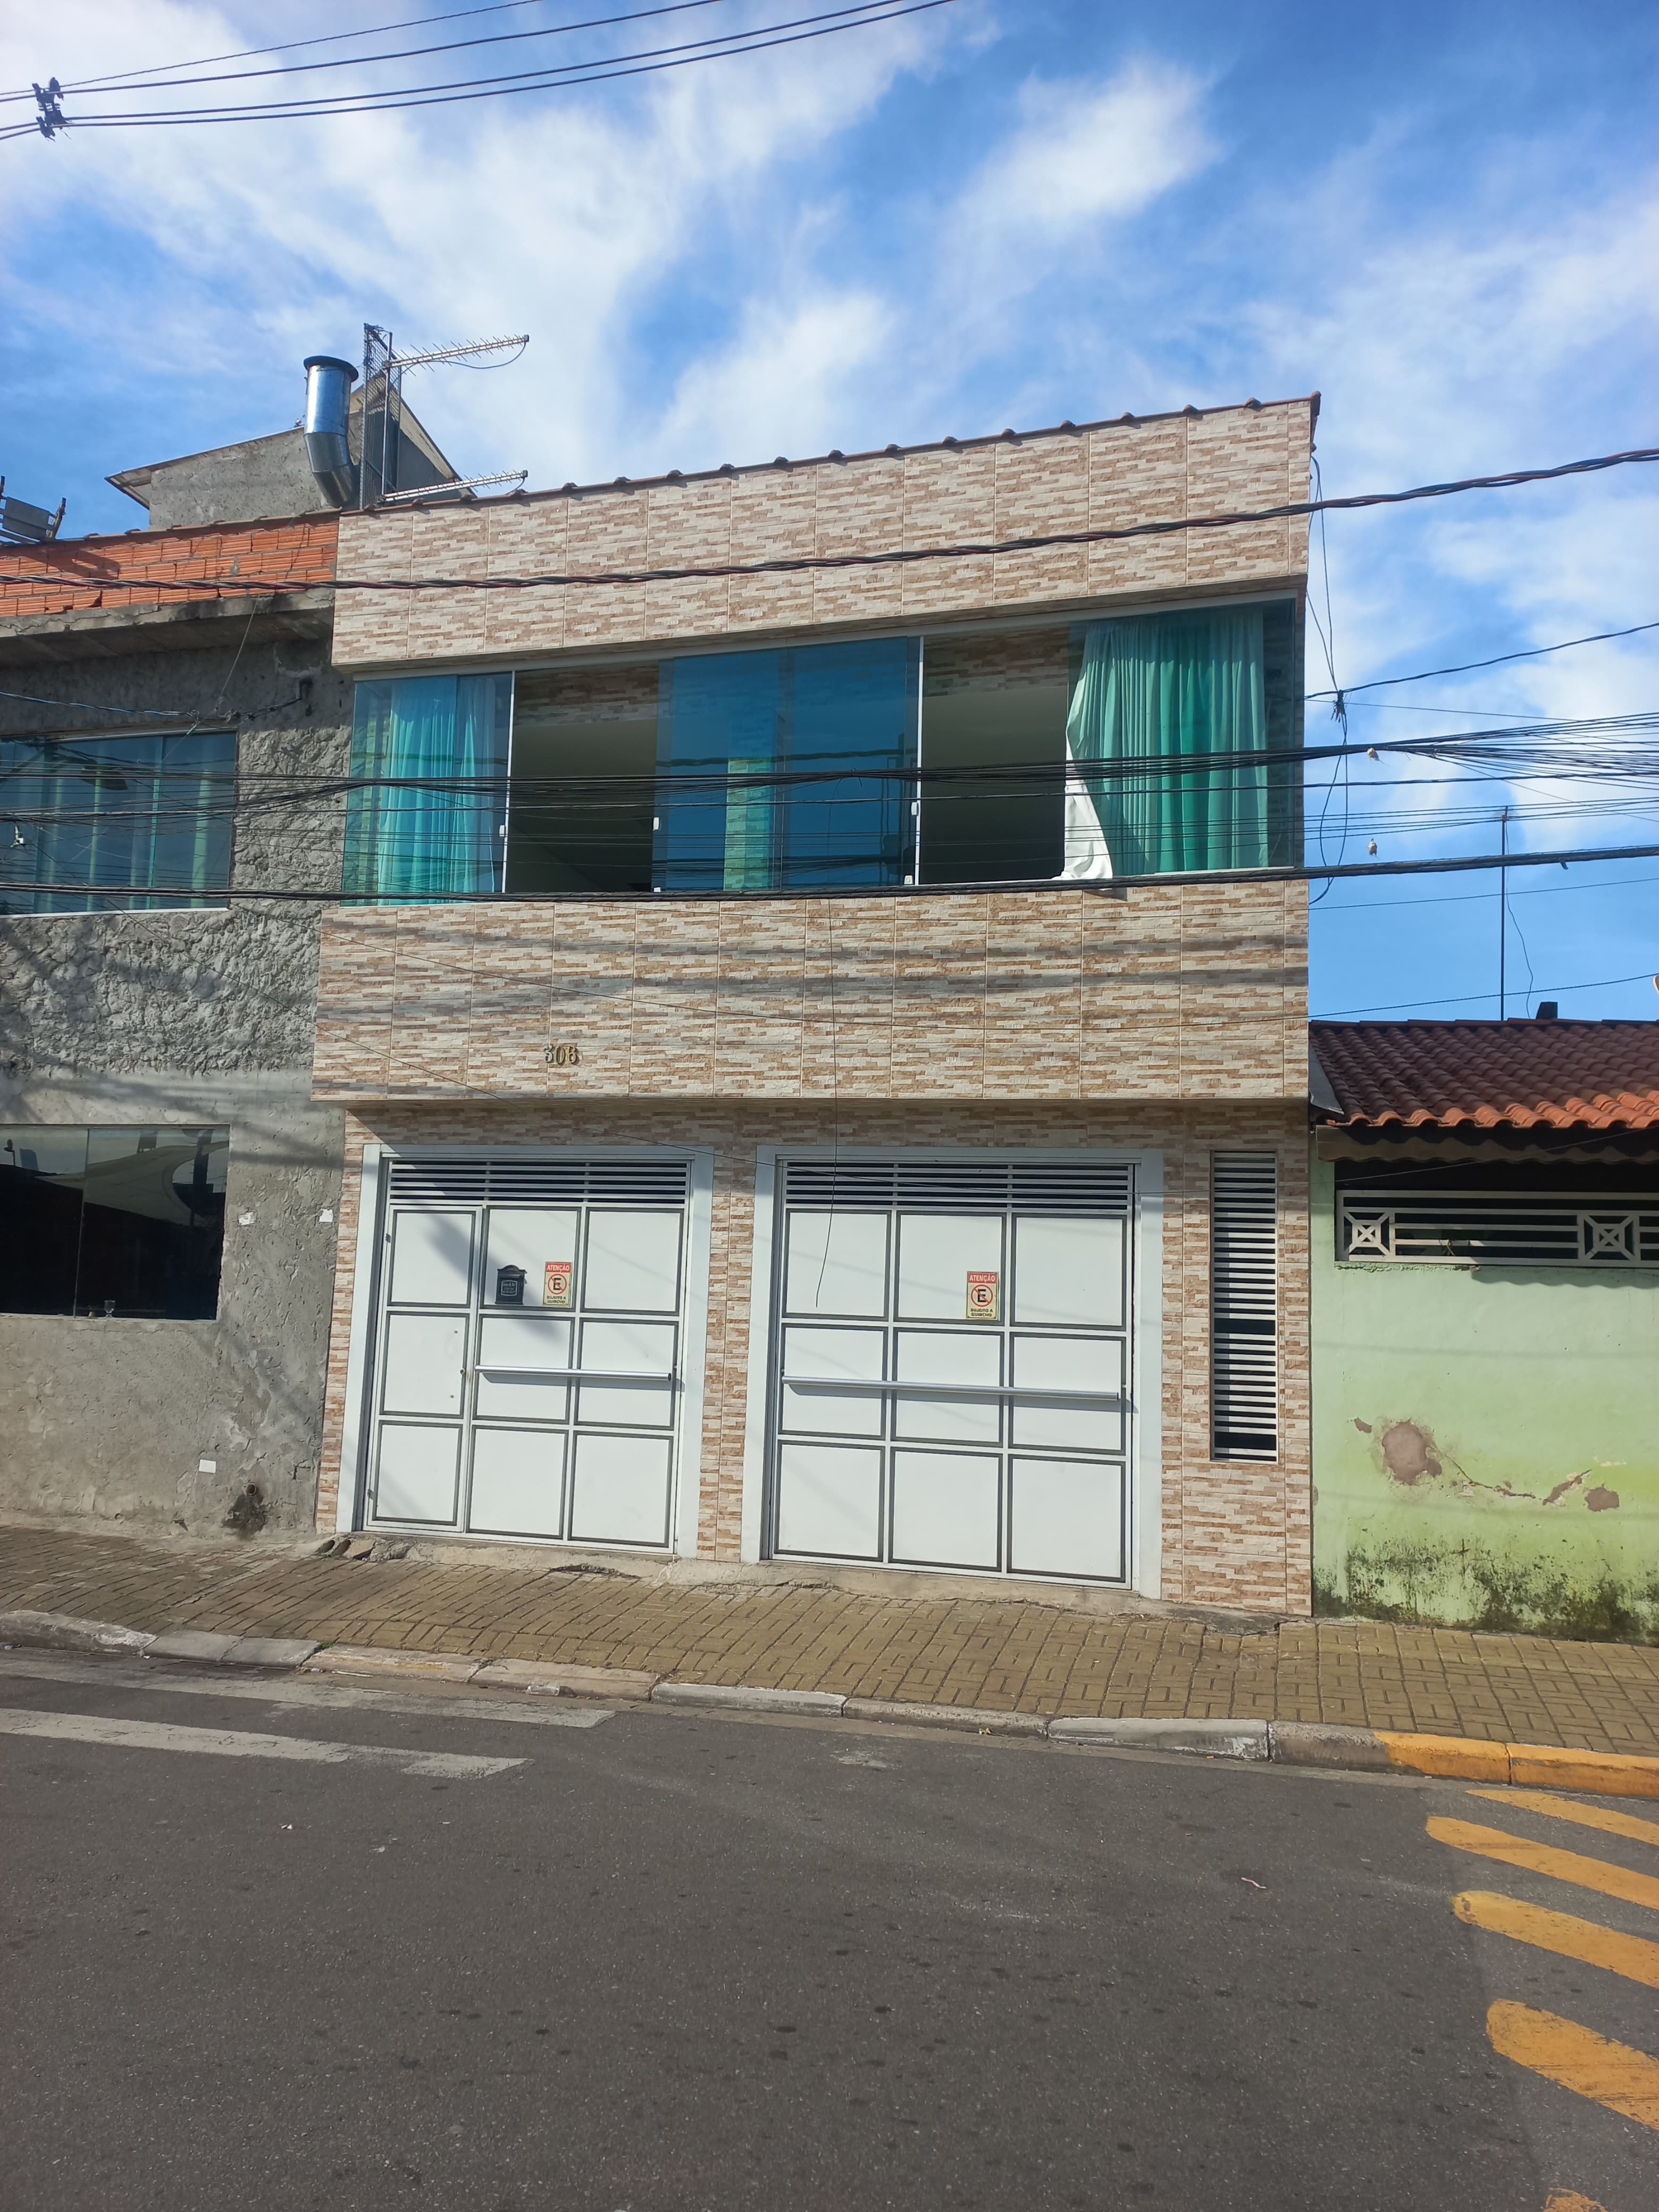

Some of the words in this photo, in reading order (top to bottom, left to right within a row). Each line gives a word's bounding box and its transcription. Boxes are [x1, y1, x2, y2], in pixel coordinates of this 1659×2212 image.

[543, 1045, 578, 1065] 306
[546, 1263, 570, 1272] ATENÇÃO
[553, 1278, 562, 1291] E
[969, 1274, 995, 1283] ATENÇÃO
[977, 1289, 986, 1302] E
